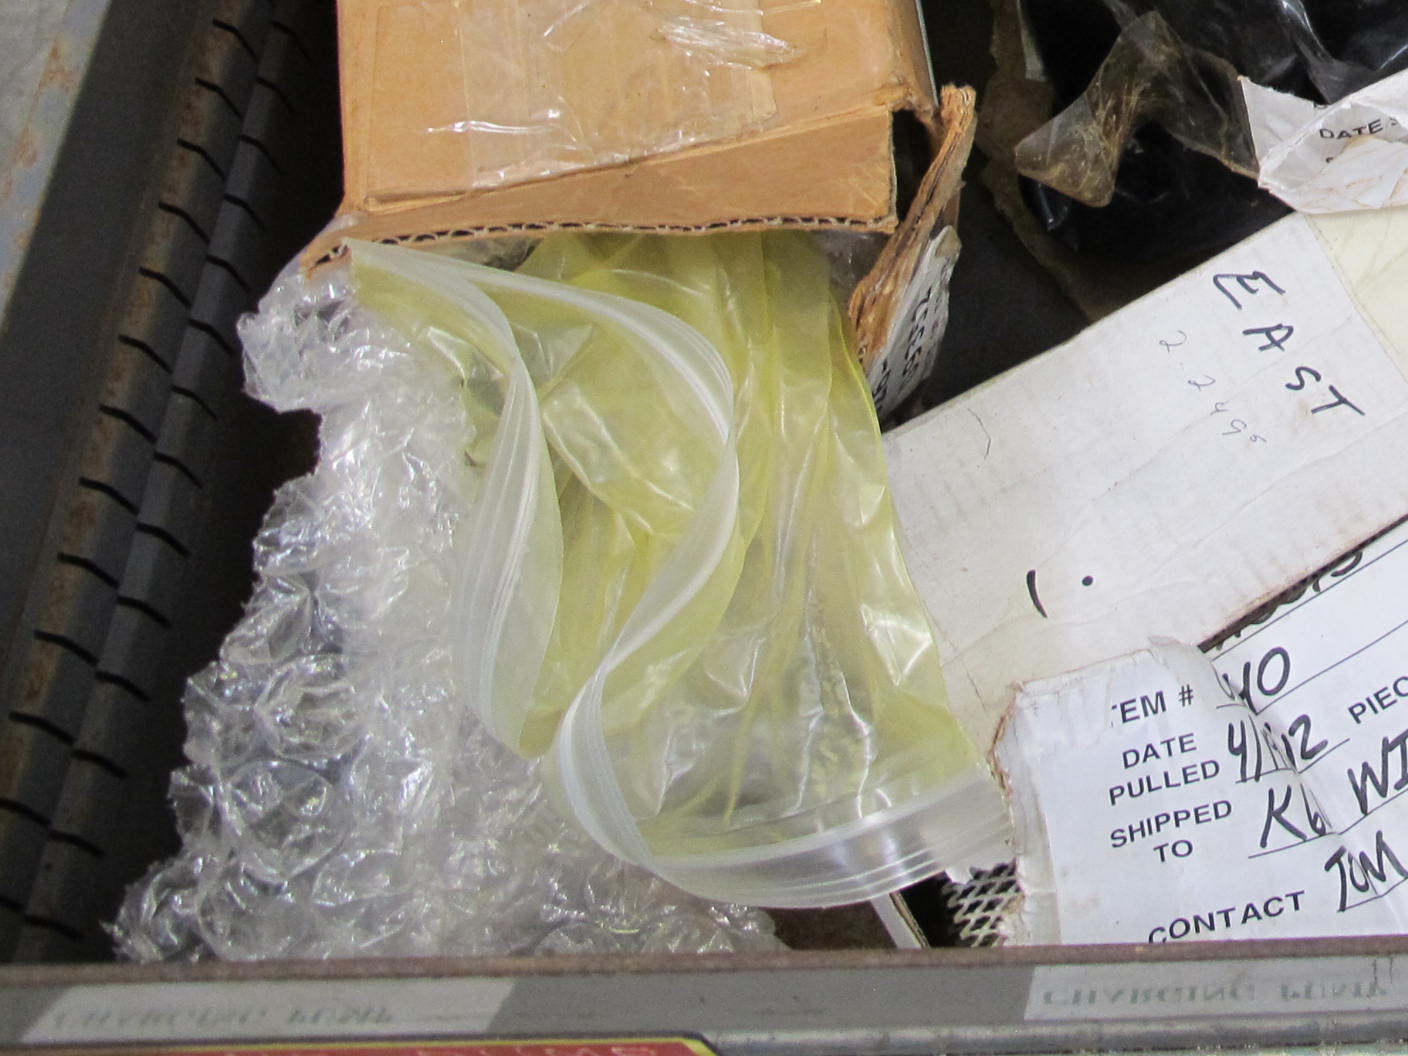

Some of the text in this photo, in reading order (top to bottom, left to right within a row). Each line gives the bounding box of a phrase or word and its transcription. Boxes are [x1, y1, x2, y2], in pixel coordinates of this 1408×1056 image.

[1319, 117, 1384, 140] DATE
[1212, 270, 1366, 416] EAST
[1178, 683, 1195, 708] #
[1121, 732, 1198, 770] DATE
[1108, 758, 1221, 806] PULLED
[1109, 799, 1233, 849] SHIPPED
[1152, 838, 1194, 863] TO
[1147, 890, 1307, 944] CONTACT
